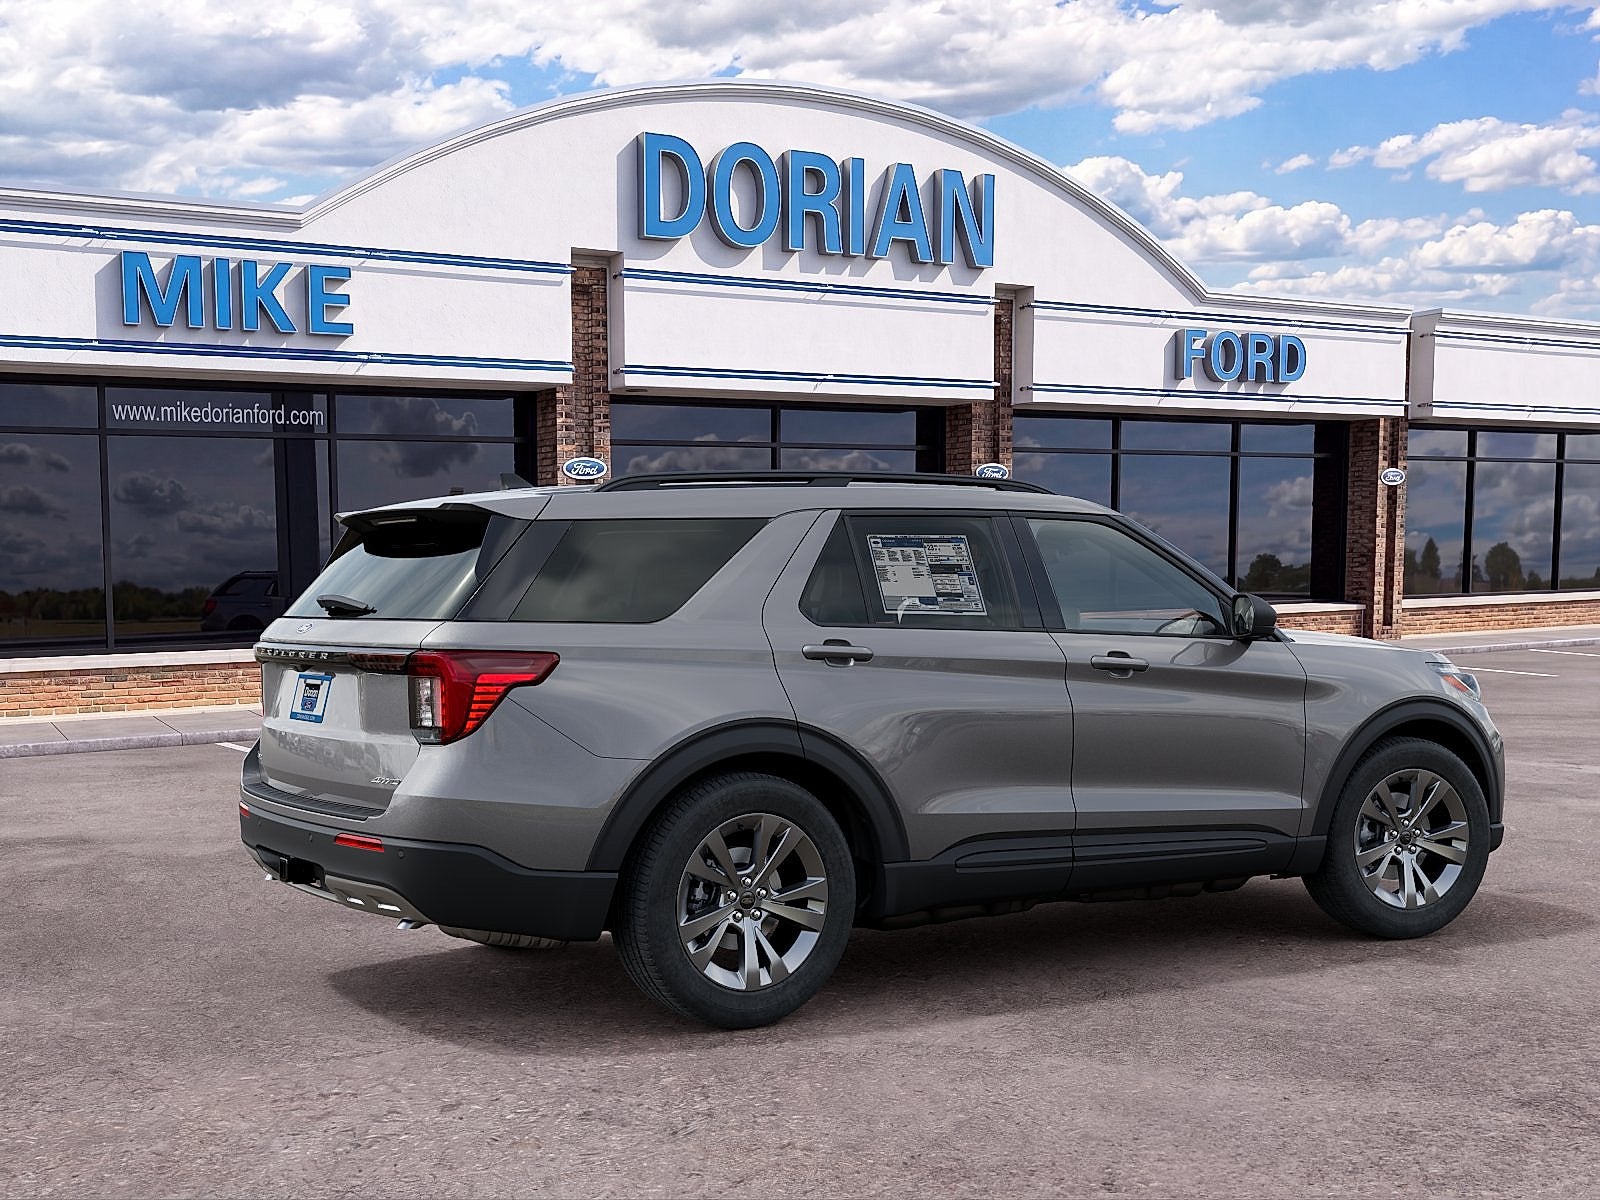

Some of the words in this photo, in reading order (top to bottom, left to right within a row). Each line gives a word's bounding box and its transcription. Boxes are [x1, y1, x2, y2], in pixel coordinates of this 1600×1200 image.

[637, 131, 995, 269] DORIAN
[120, 250, 354, 336] MIKE
[1175, 328, 1308, 384] FORD
[111, 401, 325, 426] www.mikedorianford.com
[571, 462, 599, 475] Ford
[982, 467, 1004, 479] Ford
[260, 648, 329, 660] EXPLORER
